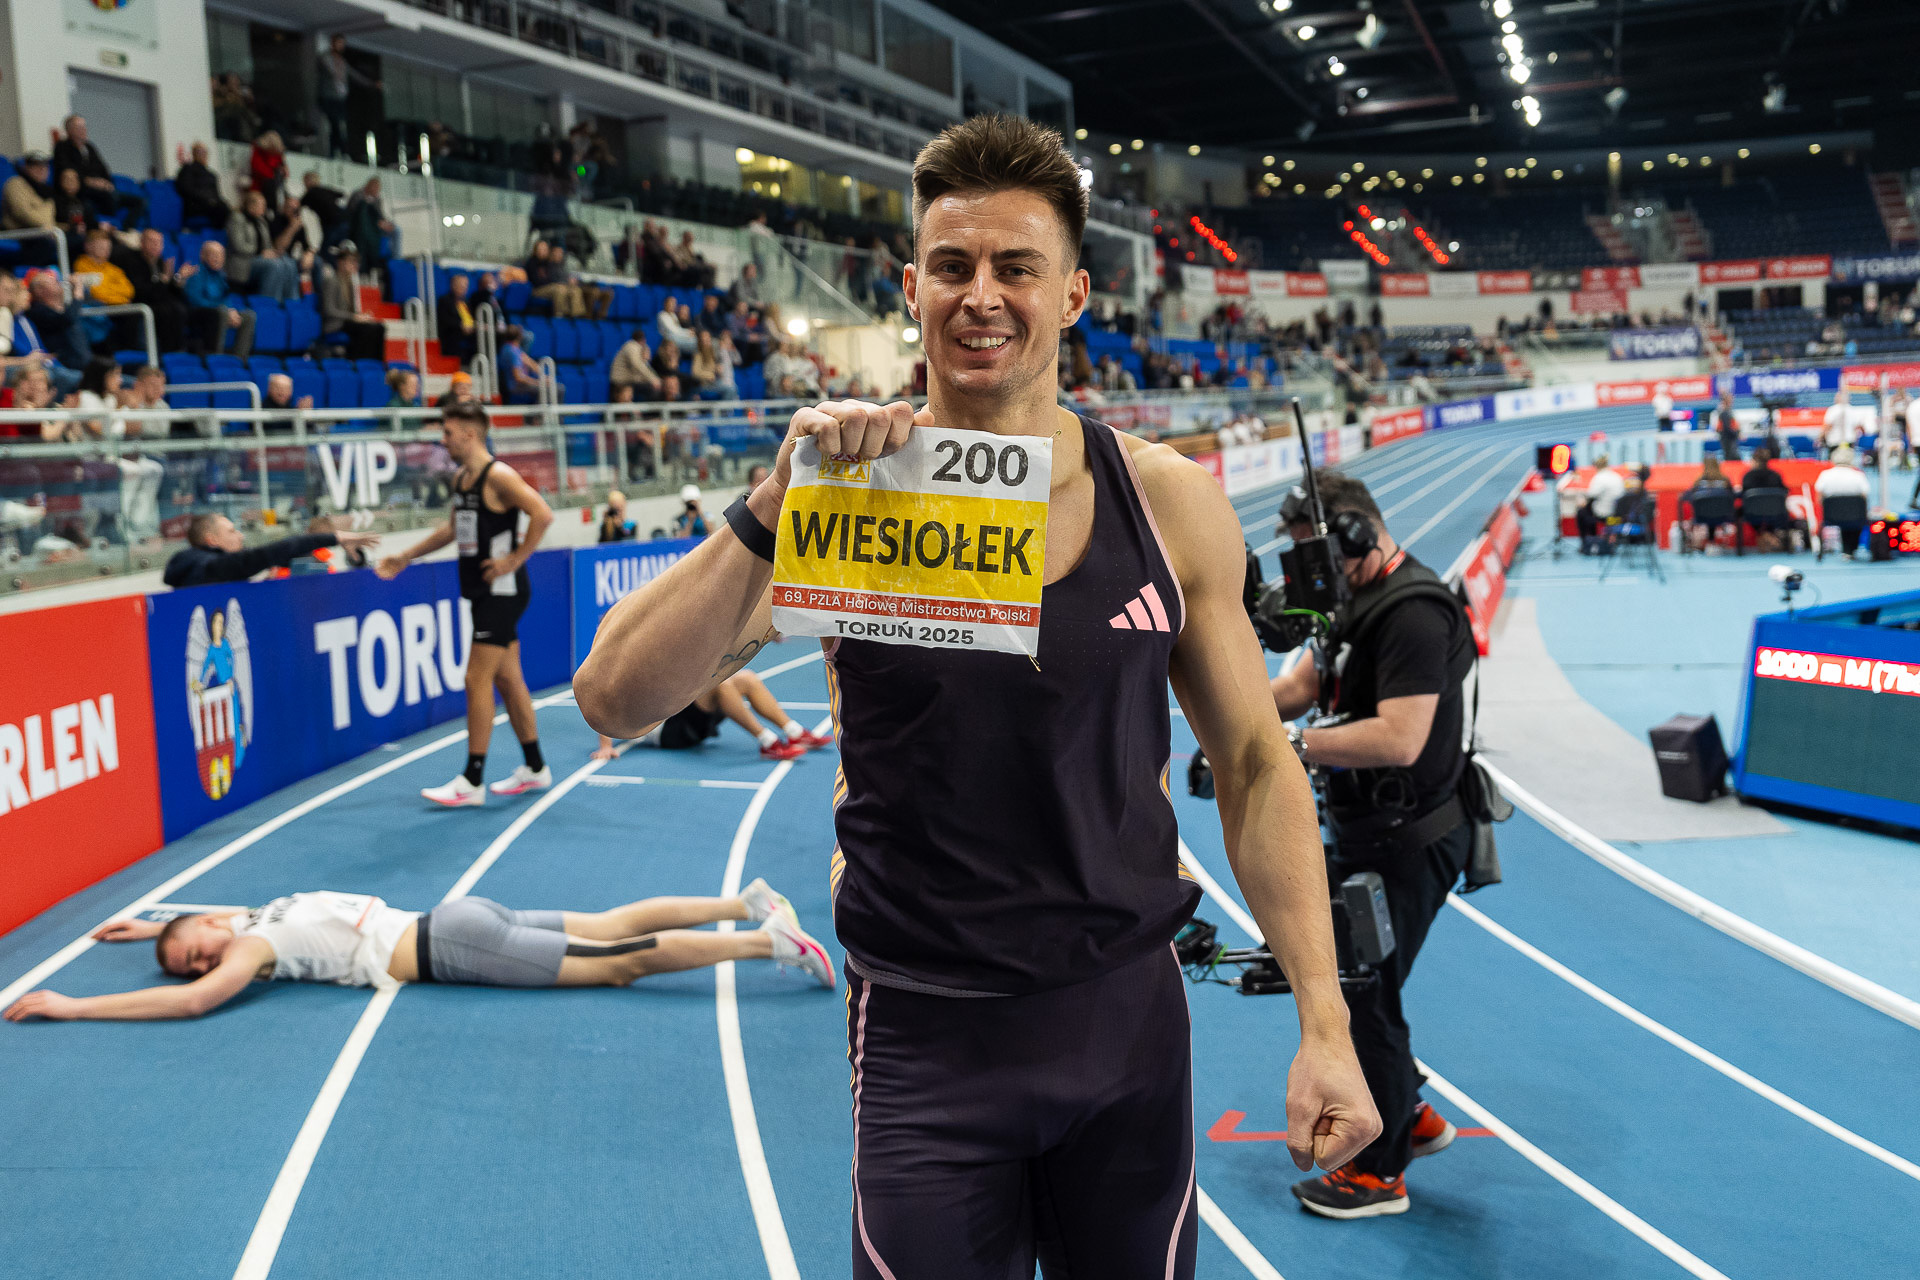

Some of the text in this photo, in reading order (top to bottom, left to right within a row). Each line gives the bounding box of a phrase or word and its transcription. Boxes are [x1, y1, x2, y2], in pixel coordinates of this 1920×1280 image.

[317, 440, 397, 510] VIP
[931, 440, 1029, 487] 200
[791, 510, 1035, 576] WIESIOŁEK
[784, 590, 1032, 623] 69. PZLA Halowe Mistrzostwa Polski
[835, 619, 974, 645] TORUŃ 2025
[314, 596, 474, 731] TORU
[1757, 649, 1819, 681] 1000
[1844, 659, 1871, 687] M
[0, 692, 120, 817] RLEN
